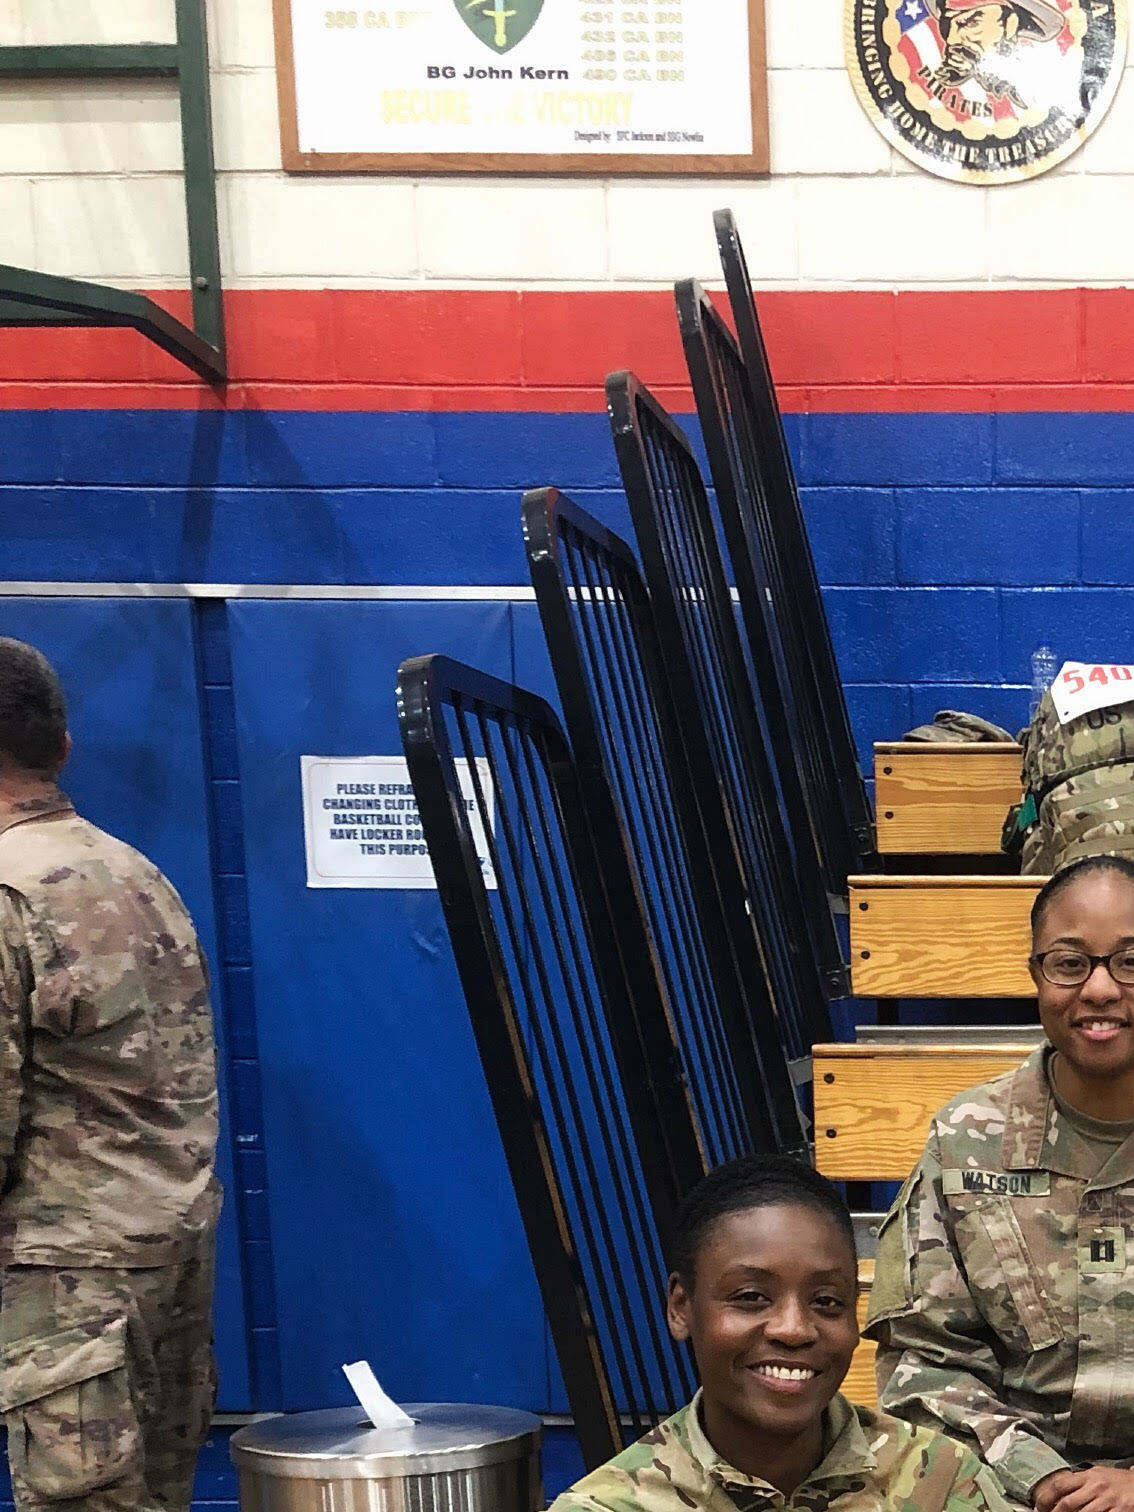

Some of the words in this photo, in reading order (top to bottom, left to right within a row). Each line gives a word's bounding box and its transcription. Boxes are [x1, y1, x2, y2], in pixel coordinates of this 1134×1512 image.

[621, 11, 648, 24] CA
[622, 30, 649, 43] CA
[623, 50, 650, 62] CA
[427, 66, 457, 80] BG
[463, 66, 513, 80] John
[520, 66, 569, 80] Kern
[623, 69, 651, 82] CA
[917, 65, 993, 117] PIRATES
[379, 89, 472, 124] SECURE
[532, 89, 633, 125] VICTORY
[888, 101, 938, 148] HOME
[942, 140, 979, 165] THE
[1063, 666, 1132, 695] 540
[336, 783, 376, 796] PLEASE
[378, 783, 415, 796] REFRA
[322, 798, 381, 810] CHANGING
[333, 813, 402, 825] BASKETBALL
[330, 829, 358, 840] HAVE
[361, 829, 403, 840] LOCKER
[360, 843, 386, 855] THIS
[961, 1171, 1031, 1194] WATSON
